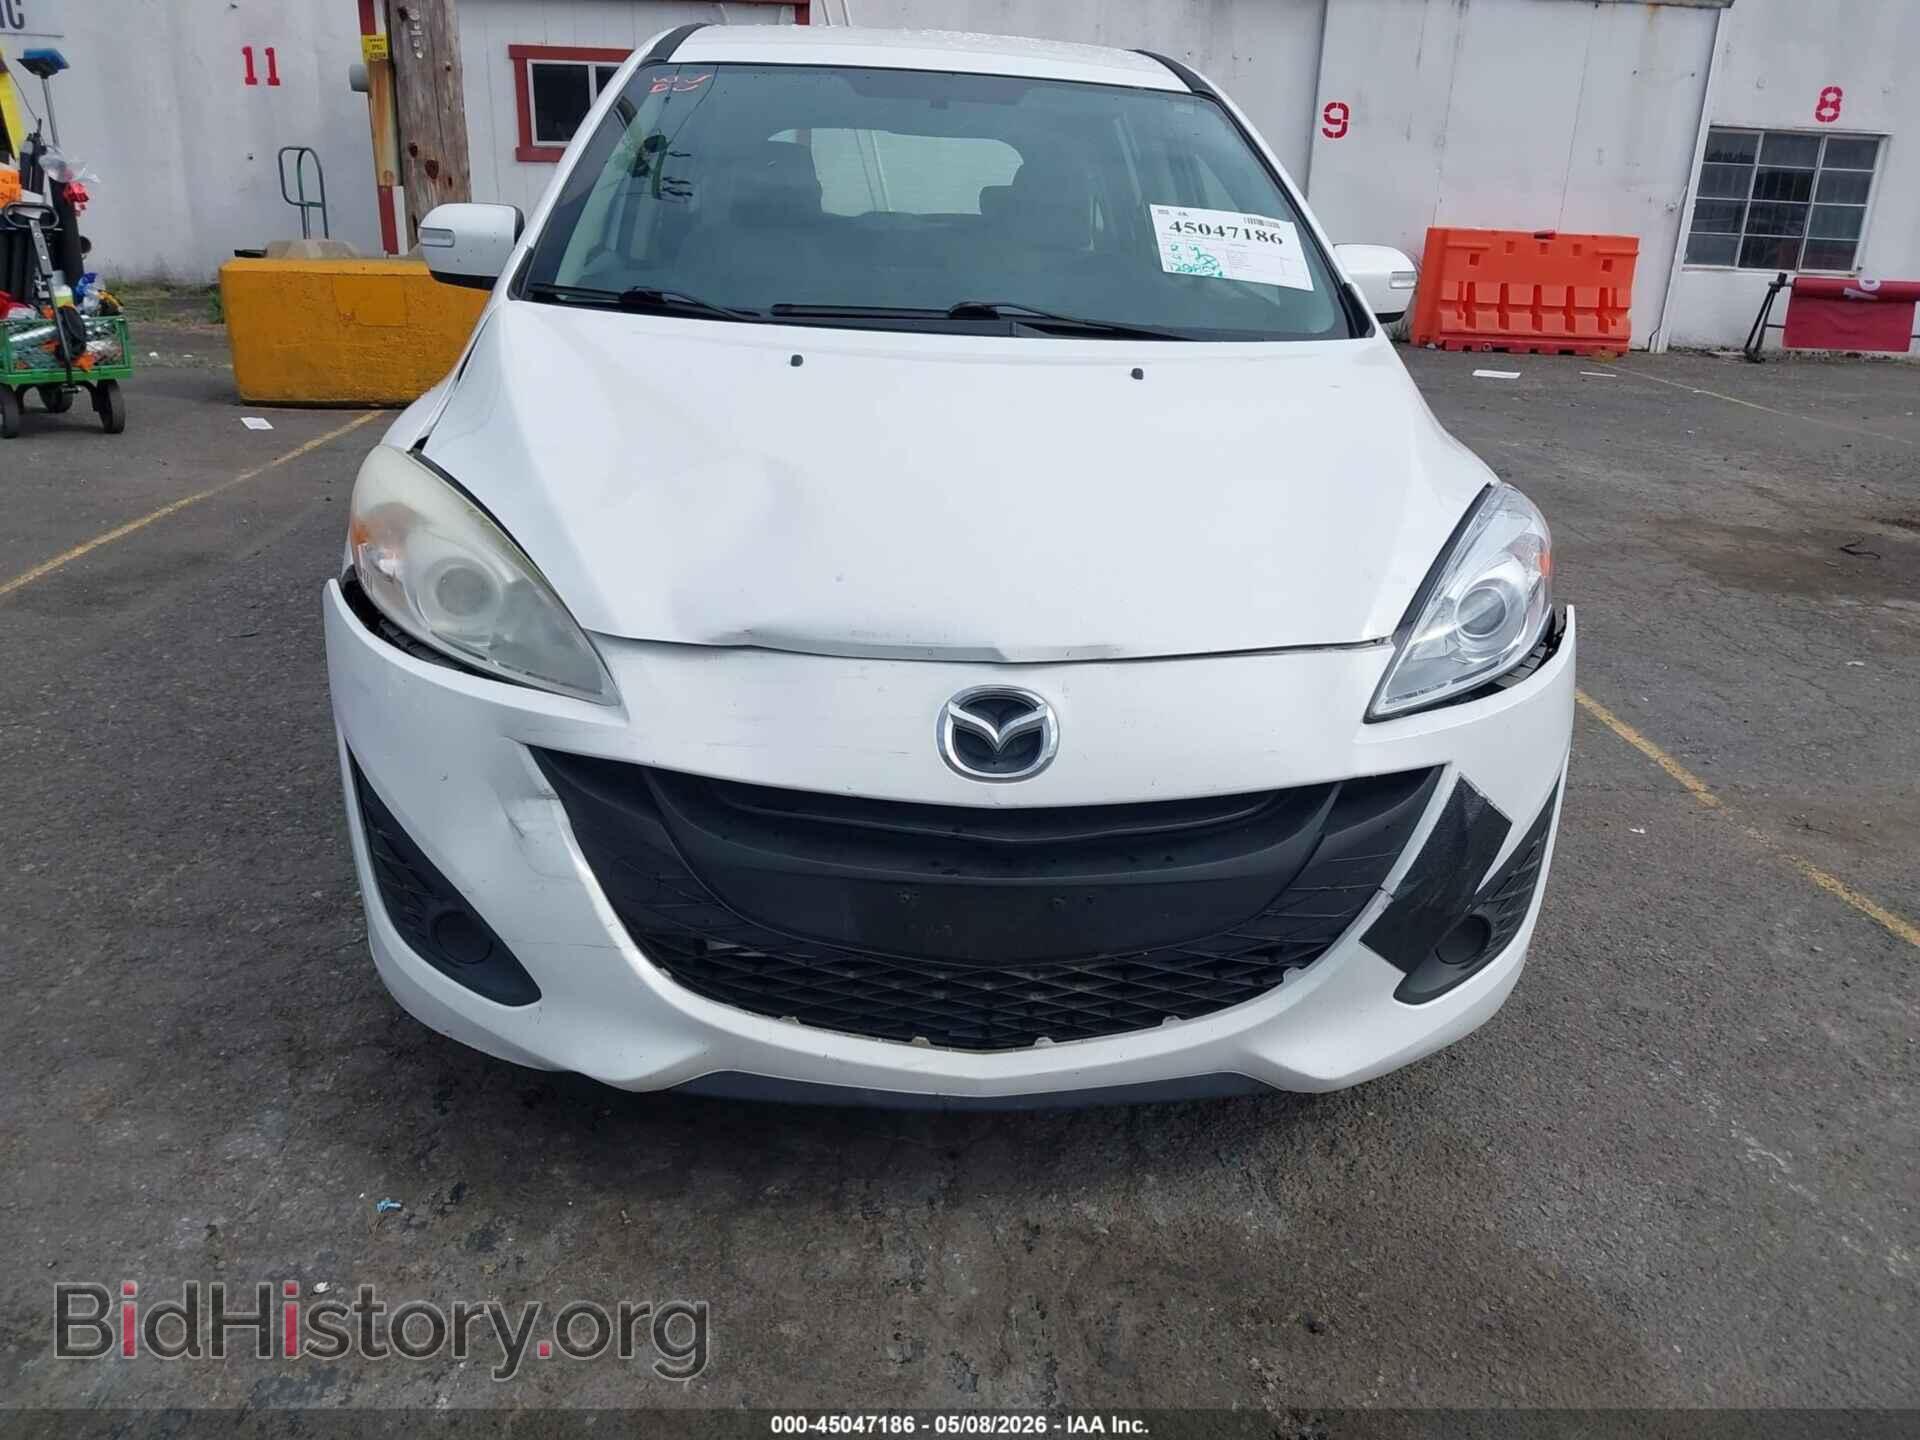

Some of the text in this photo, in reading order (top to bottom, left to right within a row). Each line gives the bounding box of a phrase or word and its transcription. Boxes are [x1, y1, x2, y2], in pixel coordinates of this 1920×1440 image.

[242, 46, 281, 86] 11
[1322, 102, 1349, 139] 9
[1815, 86, 1843, 122] 8
[1168, 220, 1283, 246] 45047186
